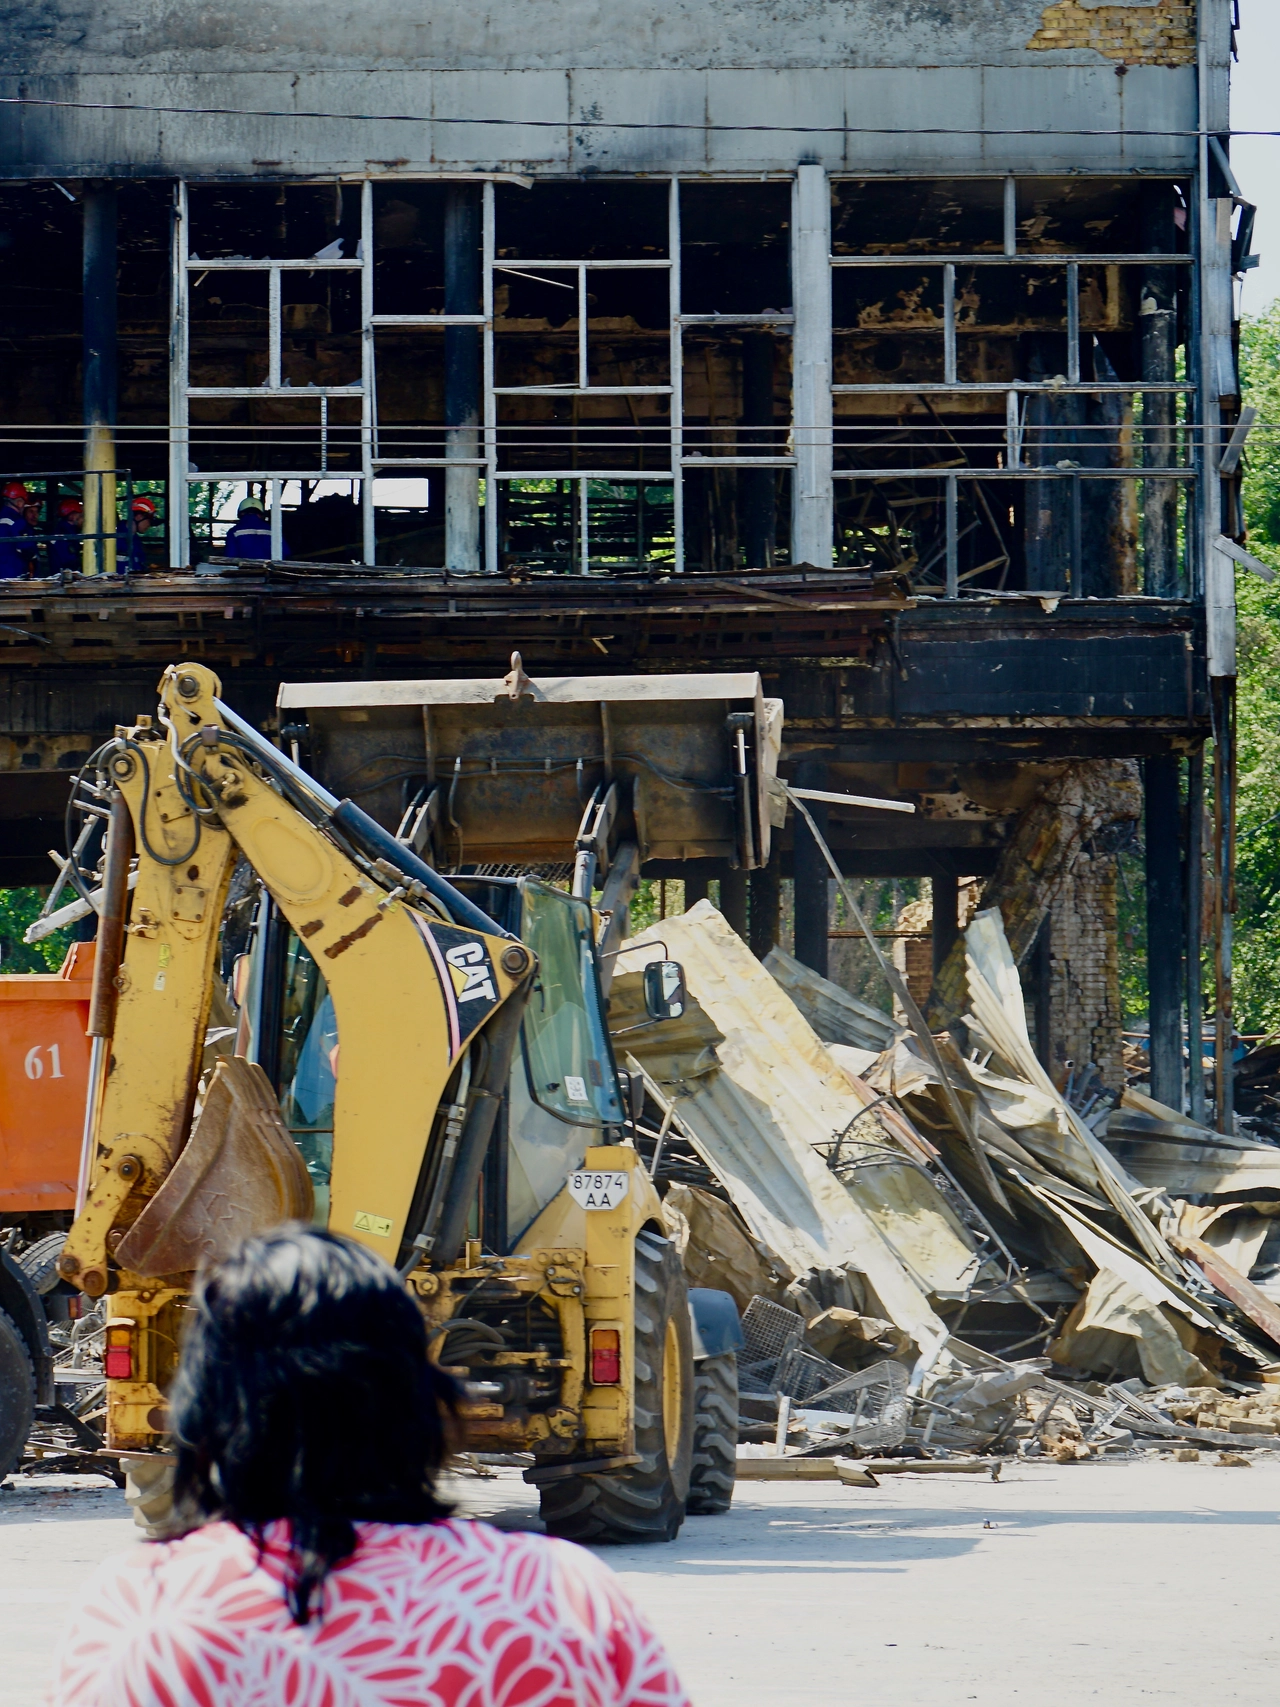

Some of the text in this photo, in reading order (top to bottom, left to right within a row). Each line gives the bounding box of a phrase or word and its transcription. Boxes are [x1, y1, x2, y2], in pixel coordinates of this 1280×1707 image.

[445, 942, 496, 1003] CAT
[24, 1043, 65, 1080] 61
[573, 1174, 623, 1190] 87874
